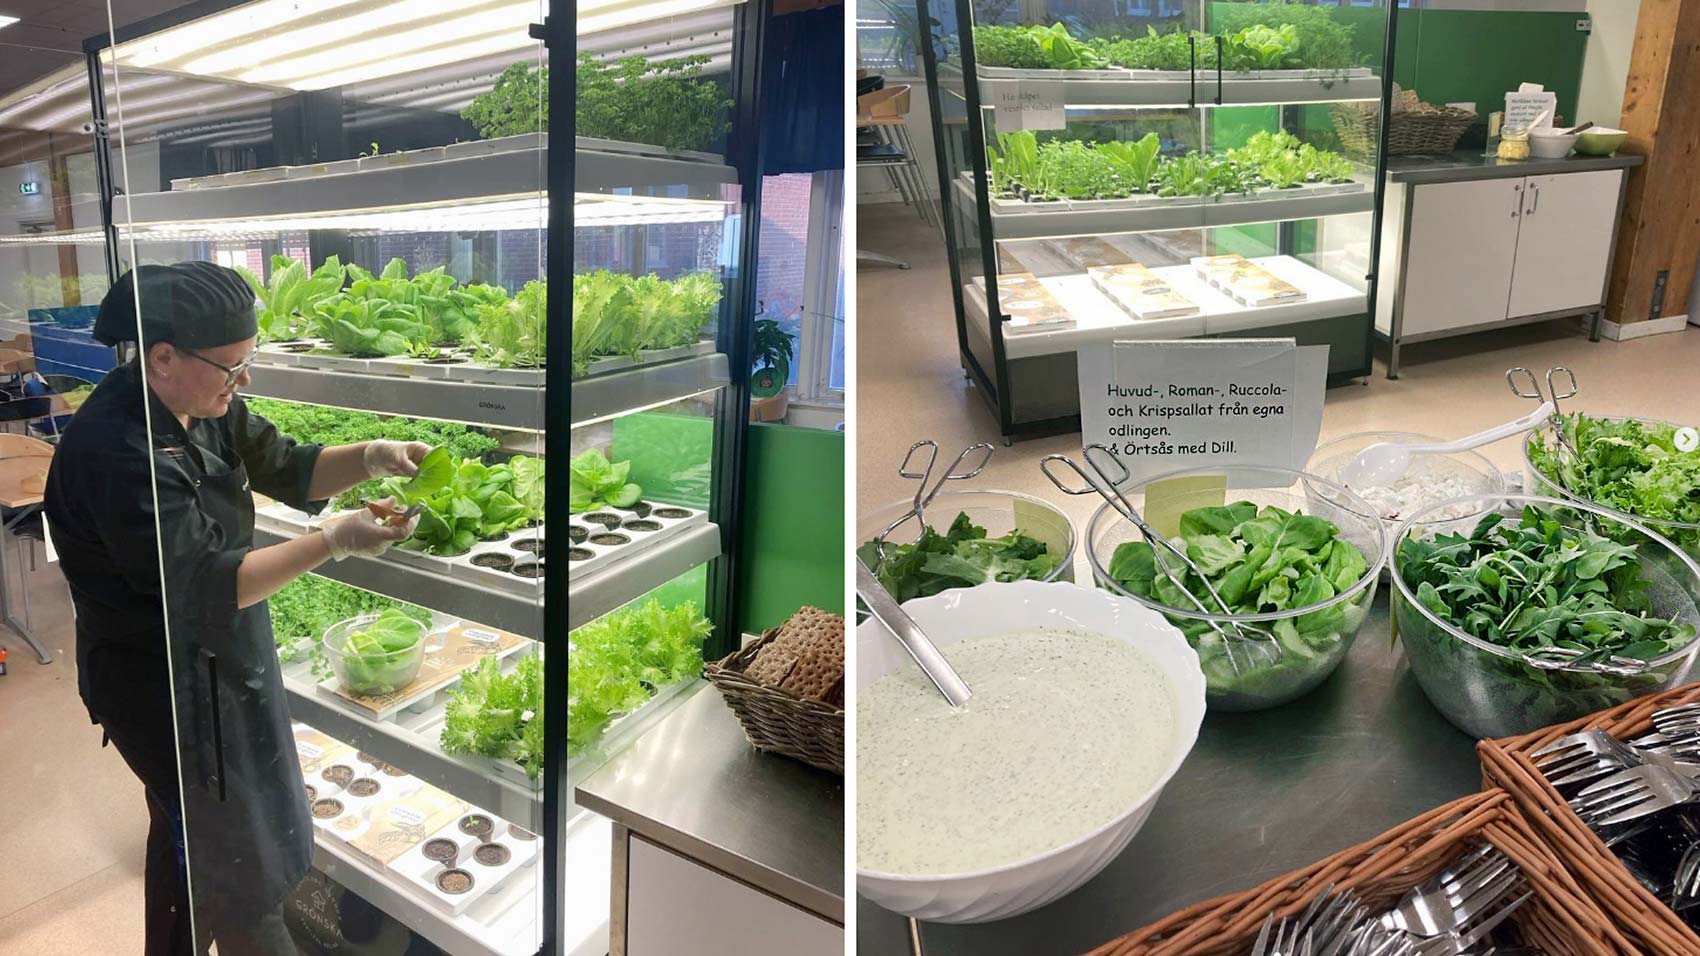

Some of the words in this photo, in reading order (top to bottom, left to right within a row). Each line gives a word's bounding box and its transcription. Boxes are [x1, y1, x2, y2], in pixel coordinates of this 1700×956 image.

[1108, 383, 1164, 399] Huvud-,
[1168, 383, 1225, 398] Roman-,
[1229, 383, 1288, 396] Ruccola-
[1108, 404, 1133, 417] och
[1139, 402, 1214, 419] Krispsallat
[1218, 401, 1249, 416] från
[1252, 405, 1285, 419] egna
[1108, 423, 1172, 440] odlingen.
[1109, 443, 1119, 456] &
[1124, 441, 1174, 456] Örtsås
[1178, 441, 1207, 455] med
[1211, 440, 1238, 454] Dill.
